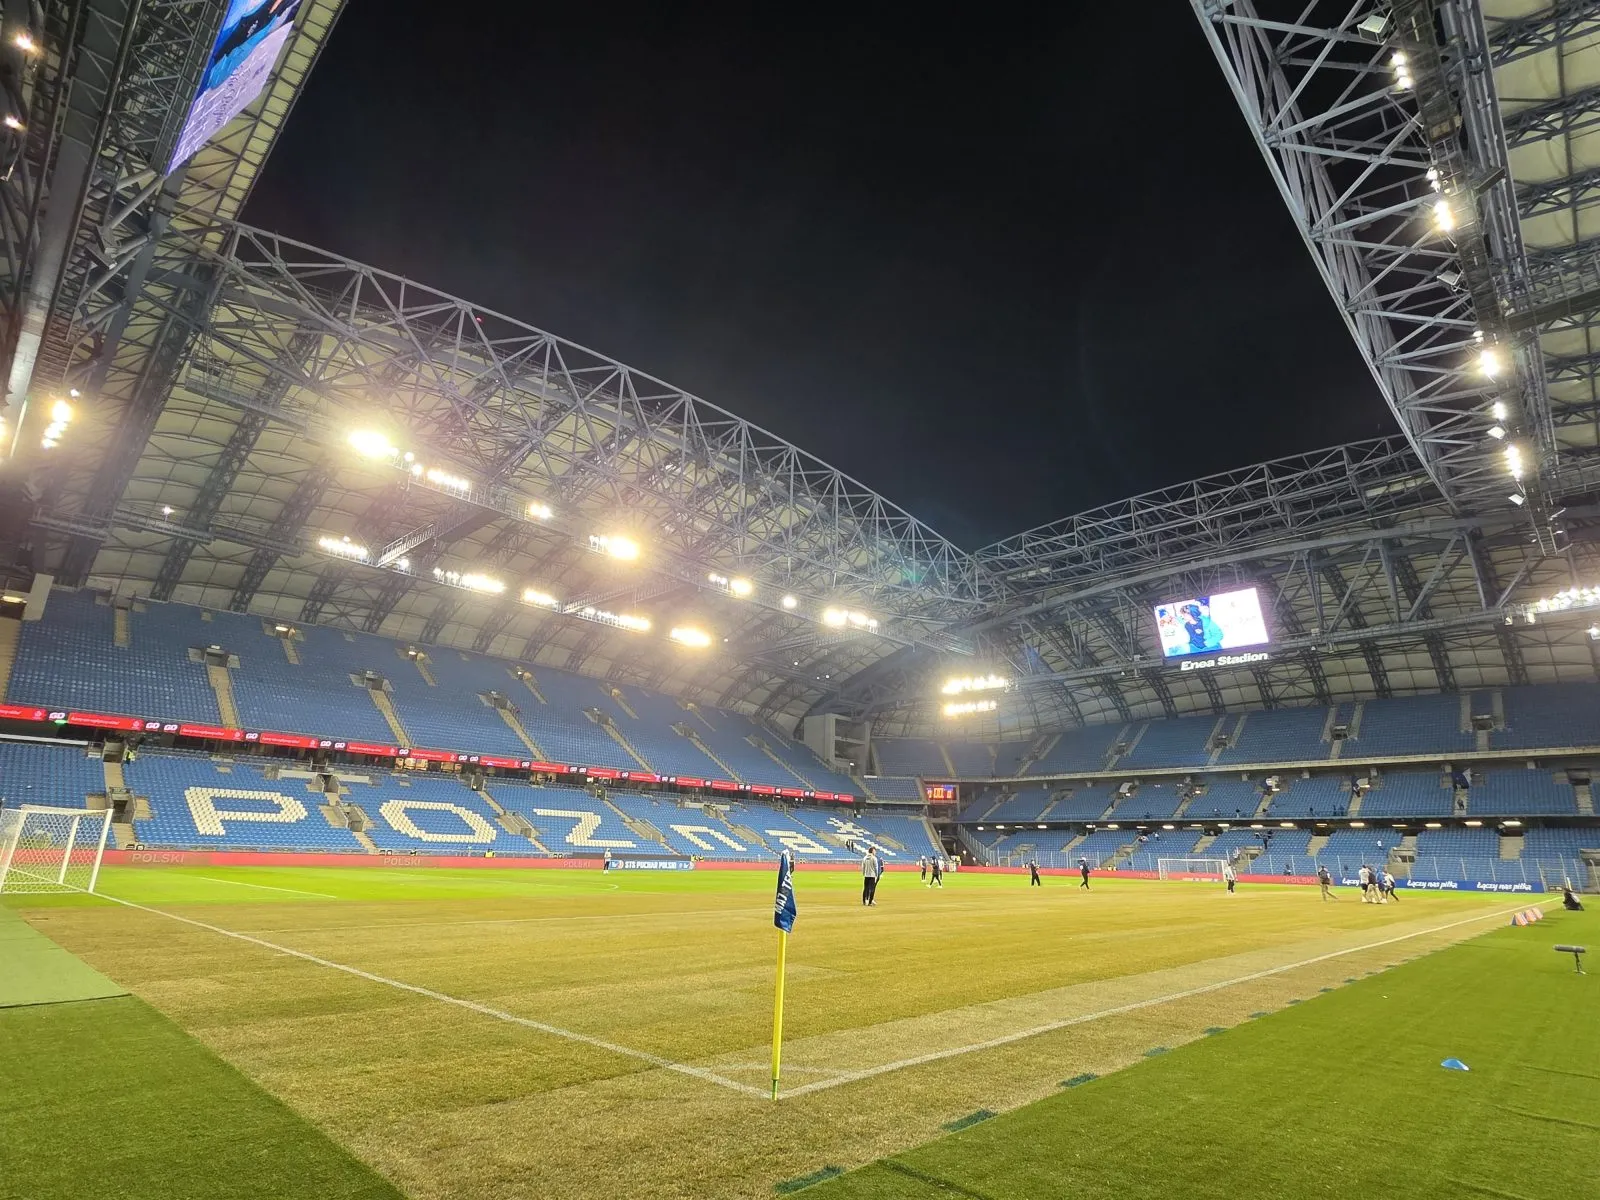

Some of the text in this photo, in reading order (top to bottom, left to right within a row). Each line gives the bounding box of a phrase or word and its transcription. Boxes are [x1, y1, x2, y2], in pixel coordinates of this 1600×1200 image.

[1181, 652, 1268, 671] Enea Stadion
[131, 853, 185, 864] POLSKI
[383, 857, 421, 867] POLSKI
[563, 860, 591, 868] POLSKI
[659, 861, 677, 870] POLSKI
[1406, 879, 1427, 889] Łączy
[1440, 880, 1458, 890] piłka
[1476, 881, 1498, 892] Łączy
[1513, 882, 1532, 893] piłka
